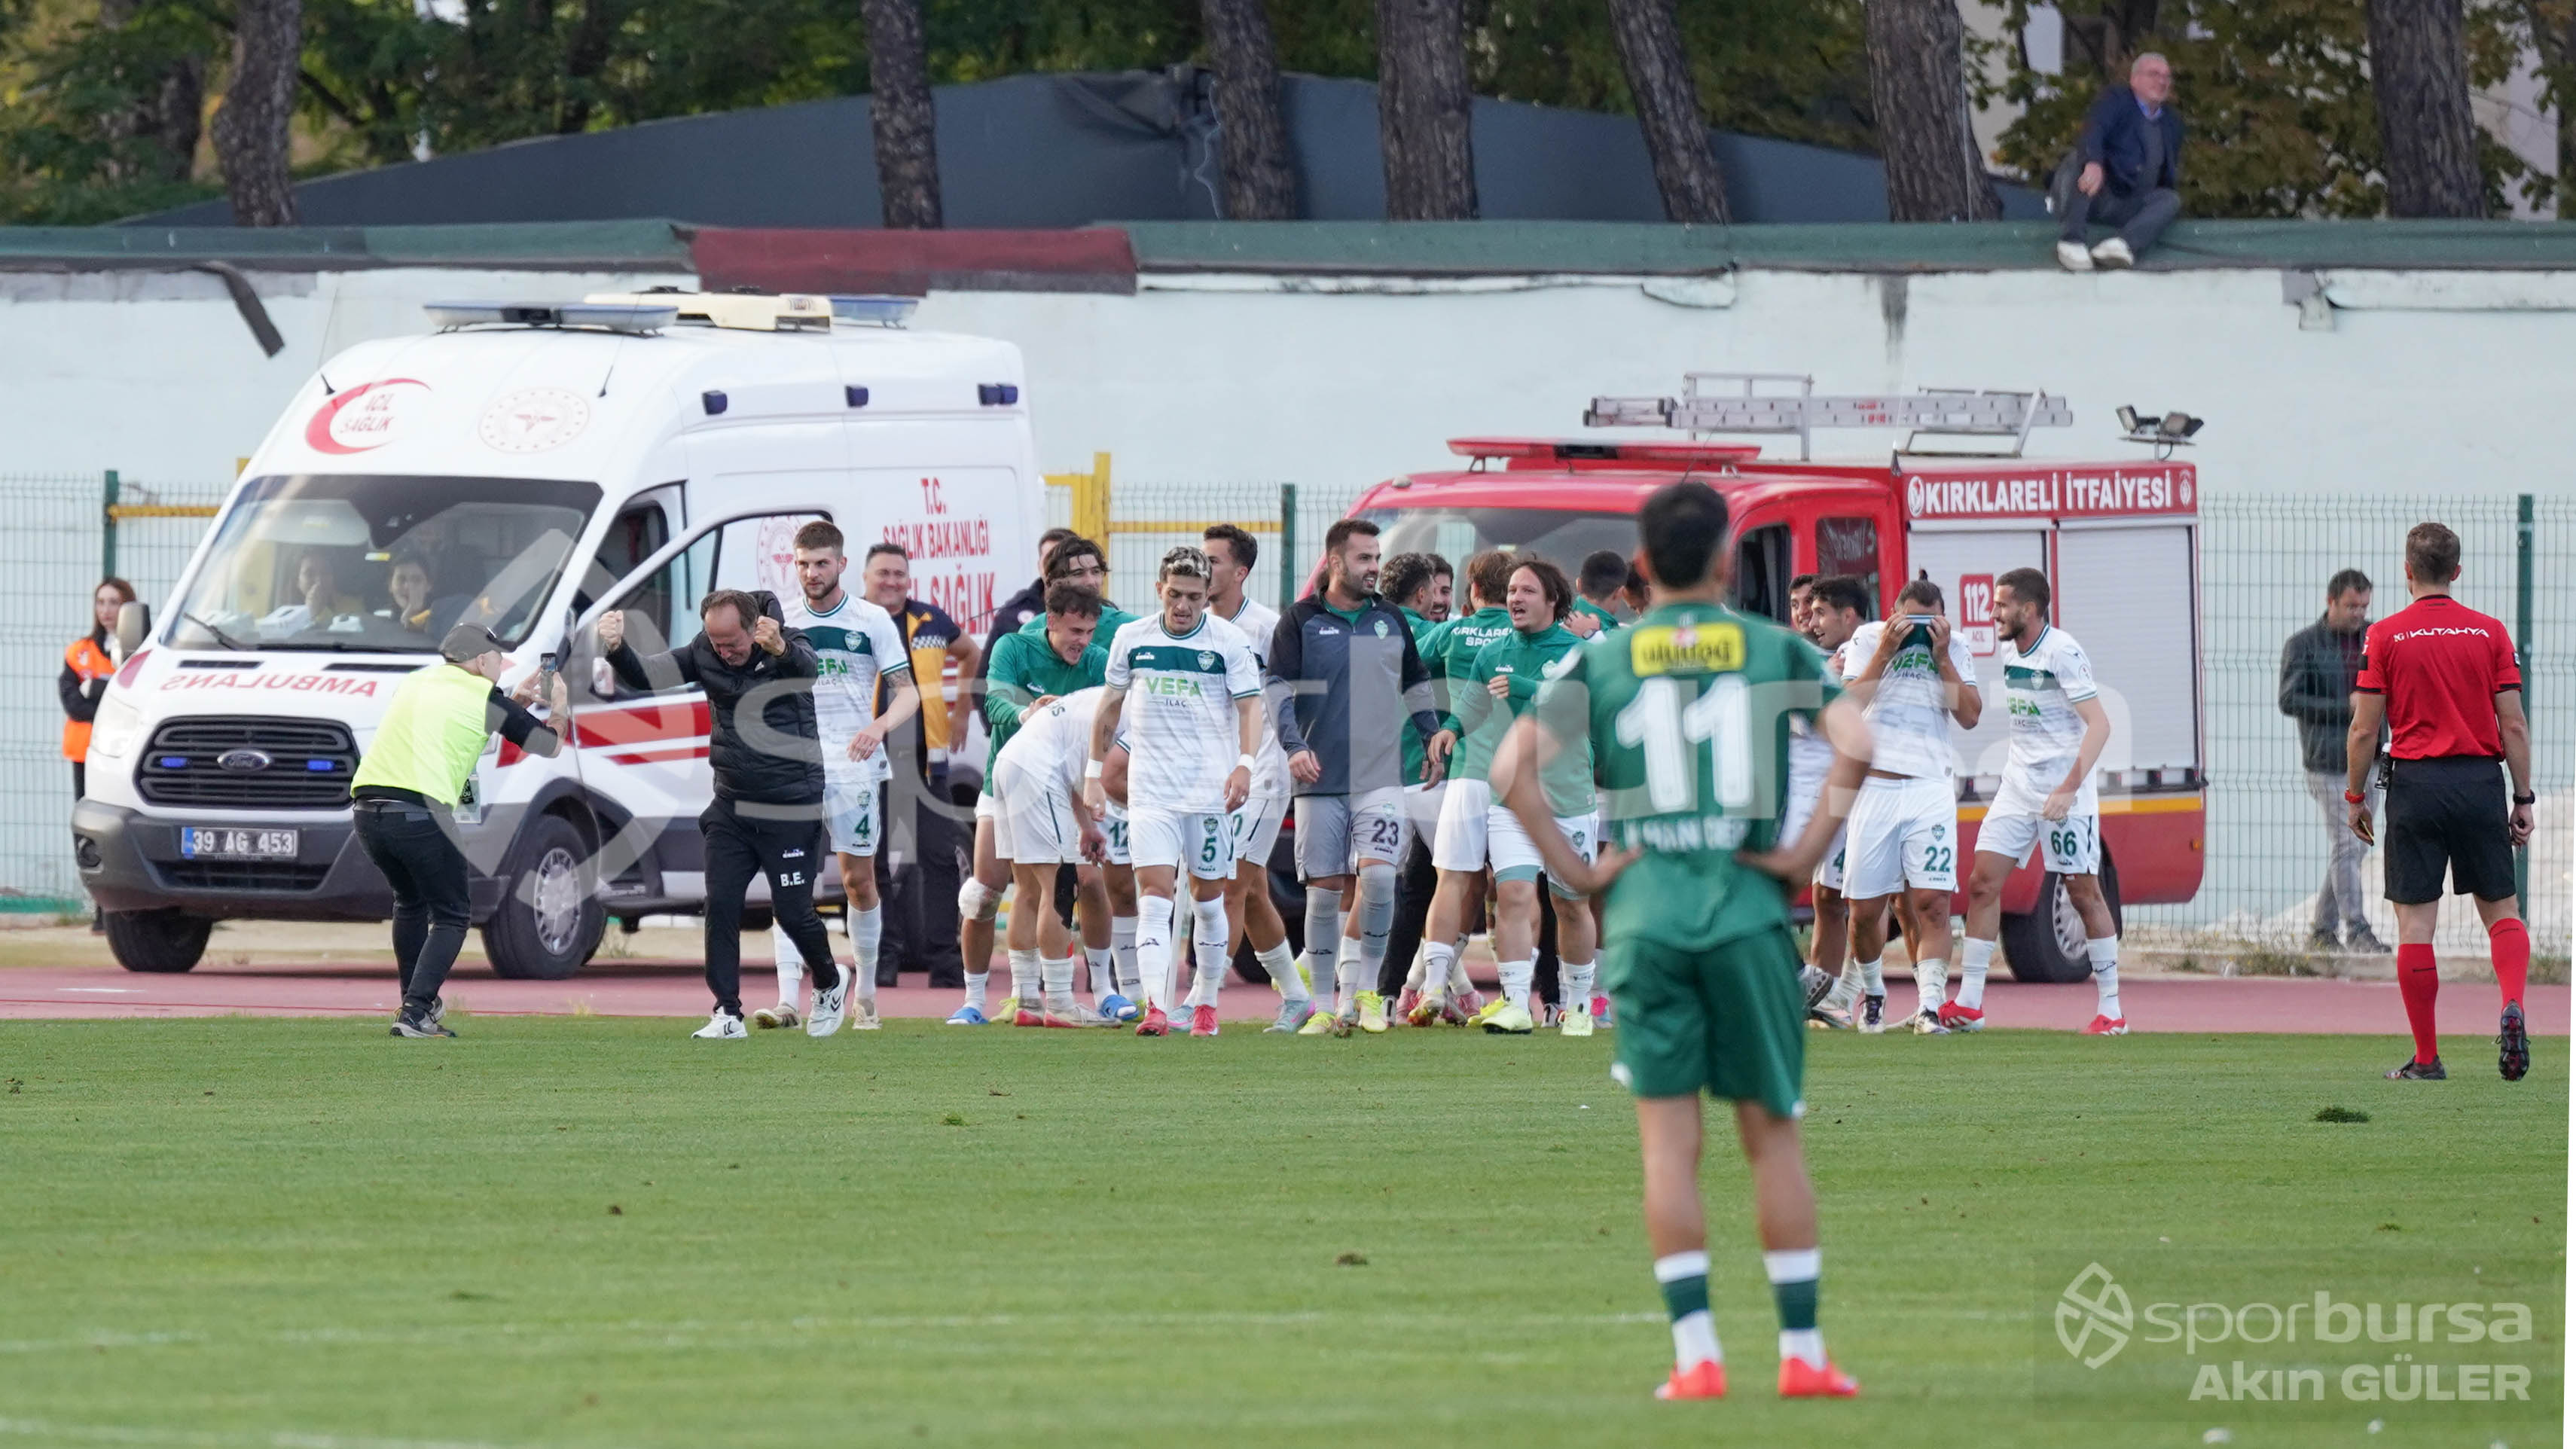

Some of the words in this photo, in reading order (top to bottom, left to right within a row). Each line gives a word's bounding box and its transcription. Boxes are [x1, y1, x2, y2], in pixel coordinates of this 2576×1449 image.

[920, 477, 947, 514] T.C.
[1925, 472, 2059, 513] KIRKLARELİ
[2066, 470, 2172, 511] İTFAİYESİ
[1964, 583, 1990, 622] 112
[1466, 636, 1498, 646] SPO
[817, 657, 849, 675] EFA
[1144, 676, 1203, 697] VEFA
[2007, 697, 2040, 716] EFA
[1616, 673, 1754, 812] 11
[854, 813, 871, 839] 4
[1372, 819, 1399, 847] 23
[192, 831, 215, 853] 39
[225, 831, 249, 853] AG
[258, 832, 293, 853] 453
[1201, 837, 1217, 863] 5
[2051, 831, 2077, 857] 66
[1924, 846, 1952, 873] 22
[780, 871, 805, 887] B.E.
